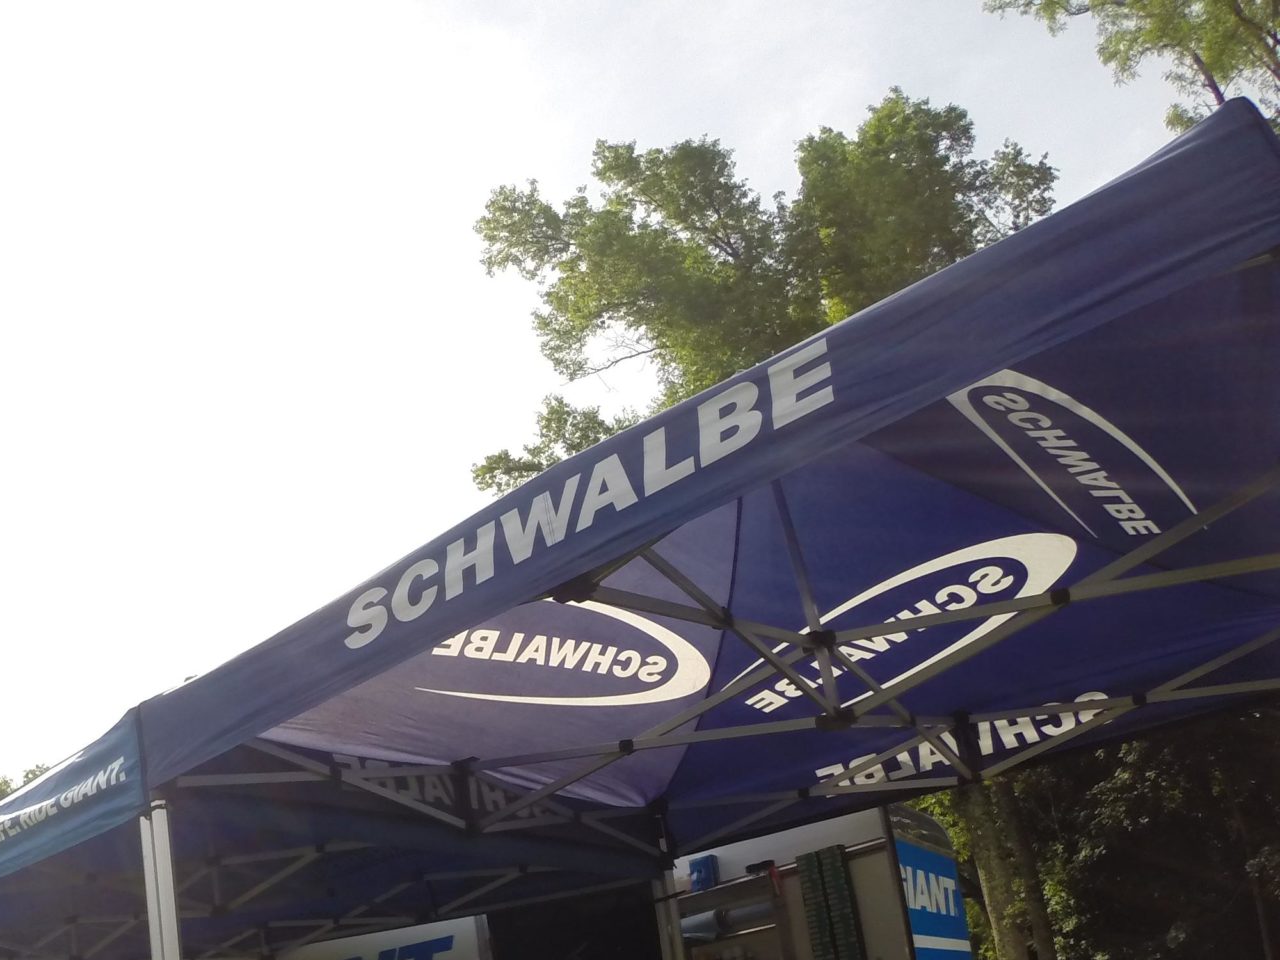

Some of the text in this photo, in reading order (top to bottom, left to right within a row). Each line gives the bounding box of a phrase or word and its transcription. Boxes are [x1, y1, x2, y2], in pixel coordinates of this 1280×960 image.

[344, 338, 835, 650] SCHWALBE
[20, 797, 58, 830] RIDE
[59, 756, 127, 809] GIANT.
